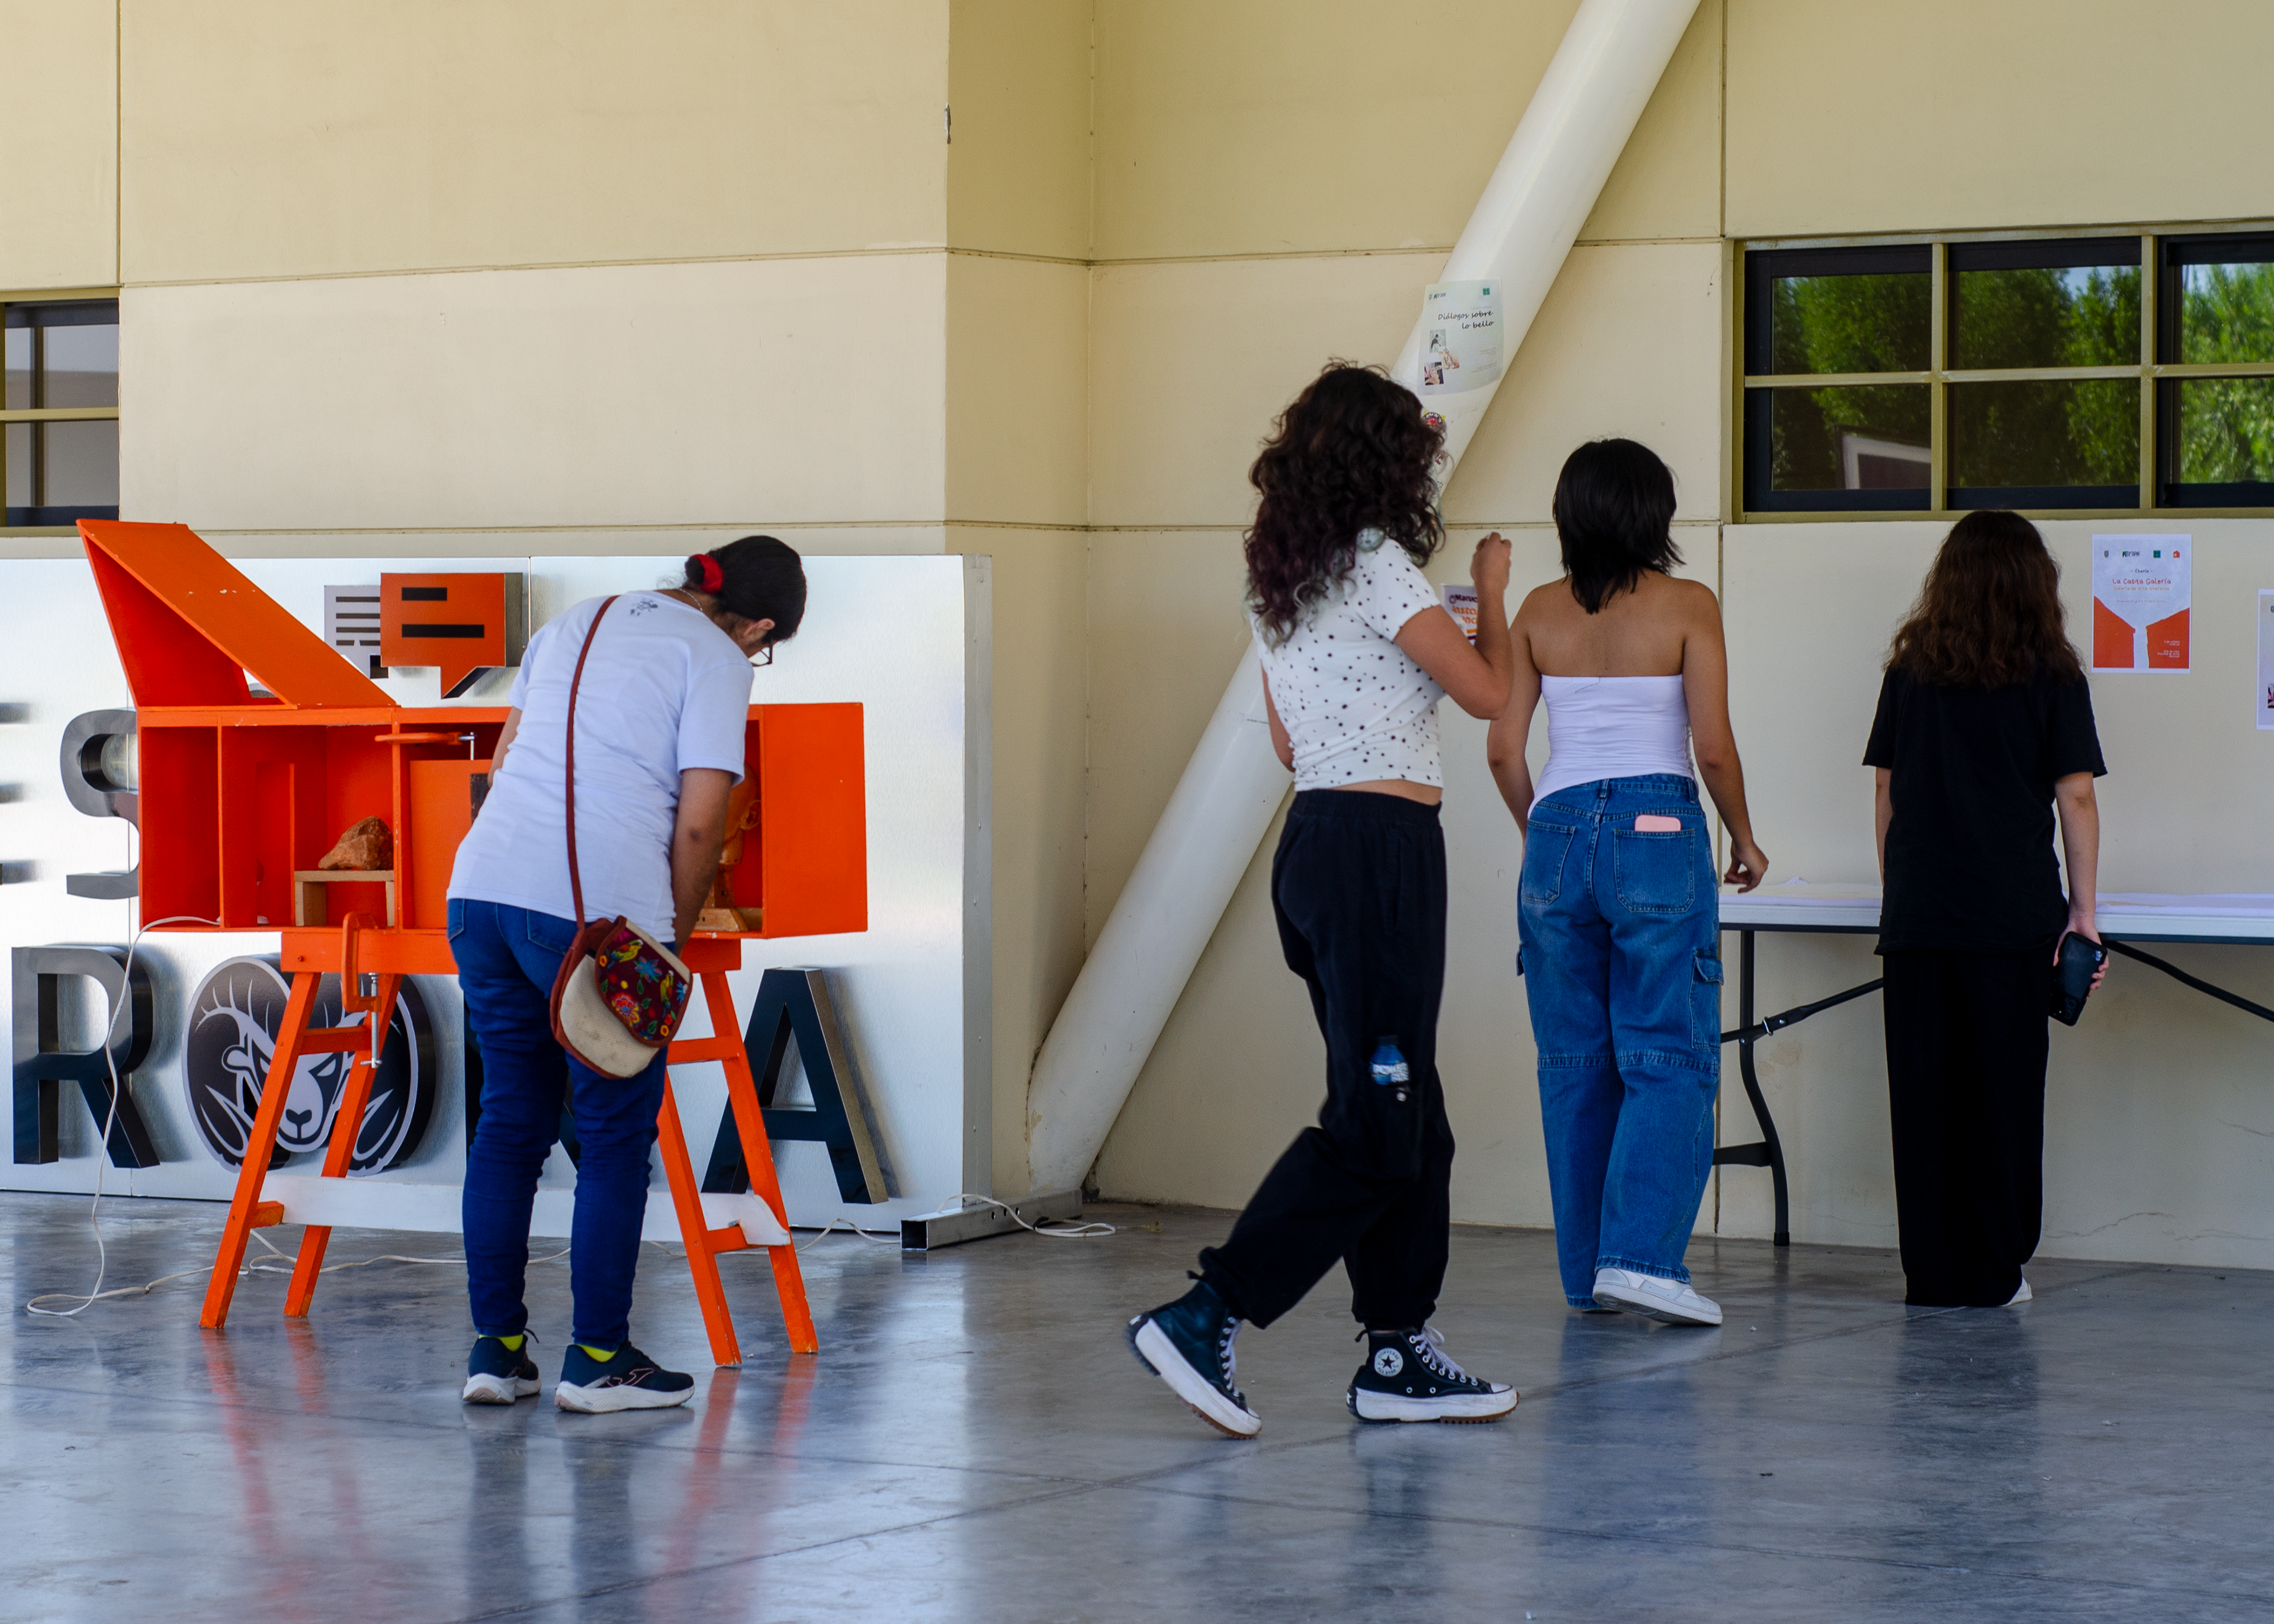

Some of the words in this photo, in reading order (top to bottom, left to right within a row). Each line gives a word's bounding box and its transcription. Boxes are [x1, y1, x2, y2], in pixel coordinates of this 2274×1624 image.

[1438, 313, 1469, 321] Diálogos
[1471, 310, 1493, 319] sobre
[1473, 320, 1495, 329] bello
